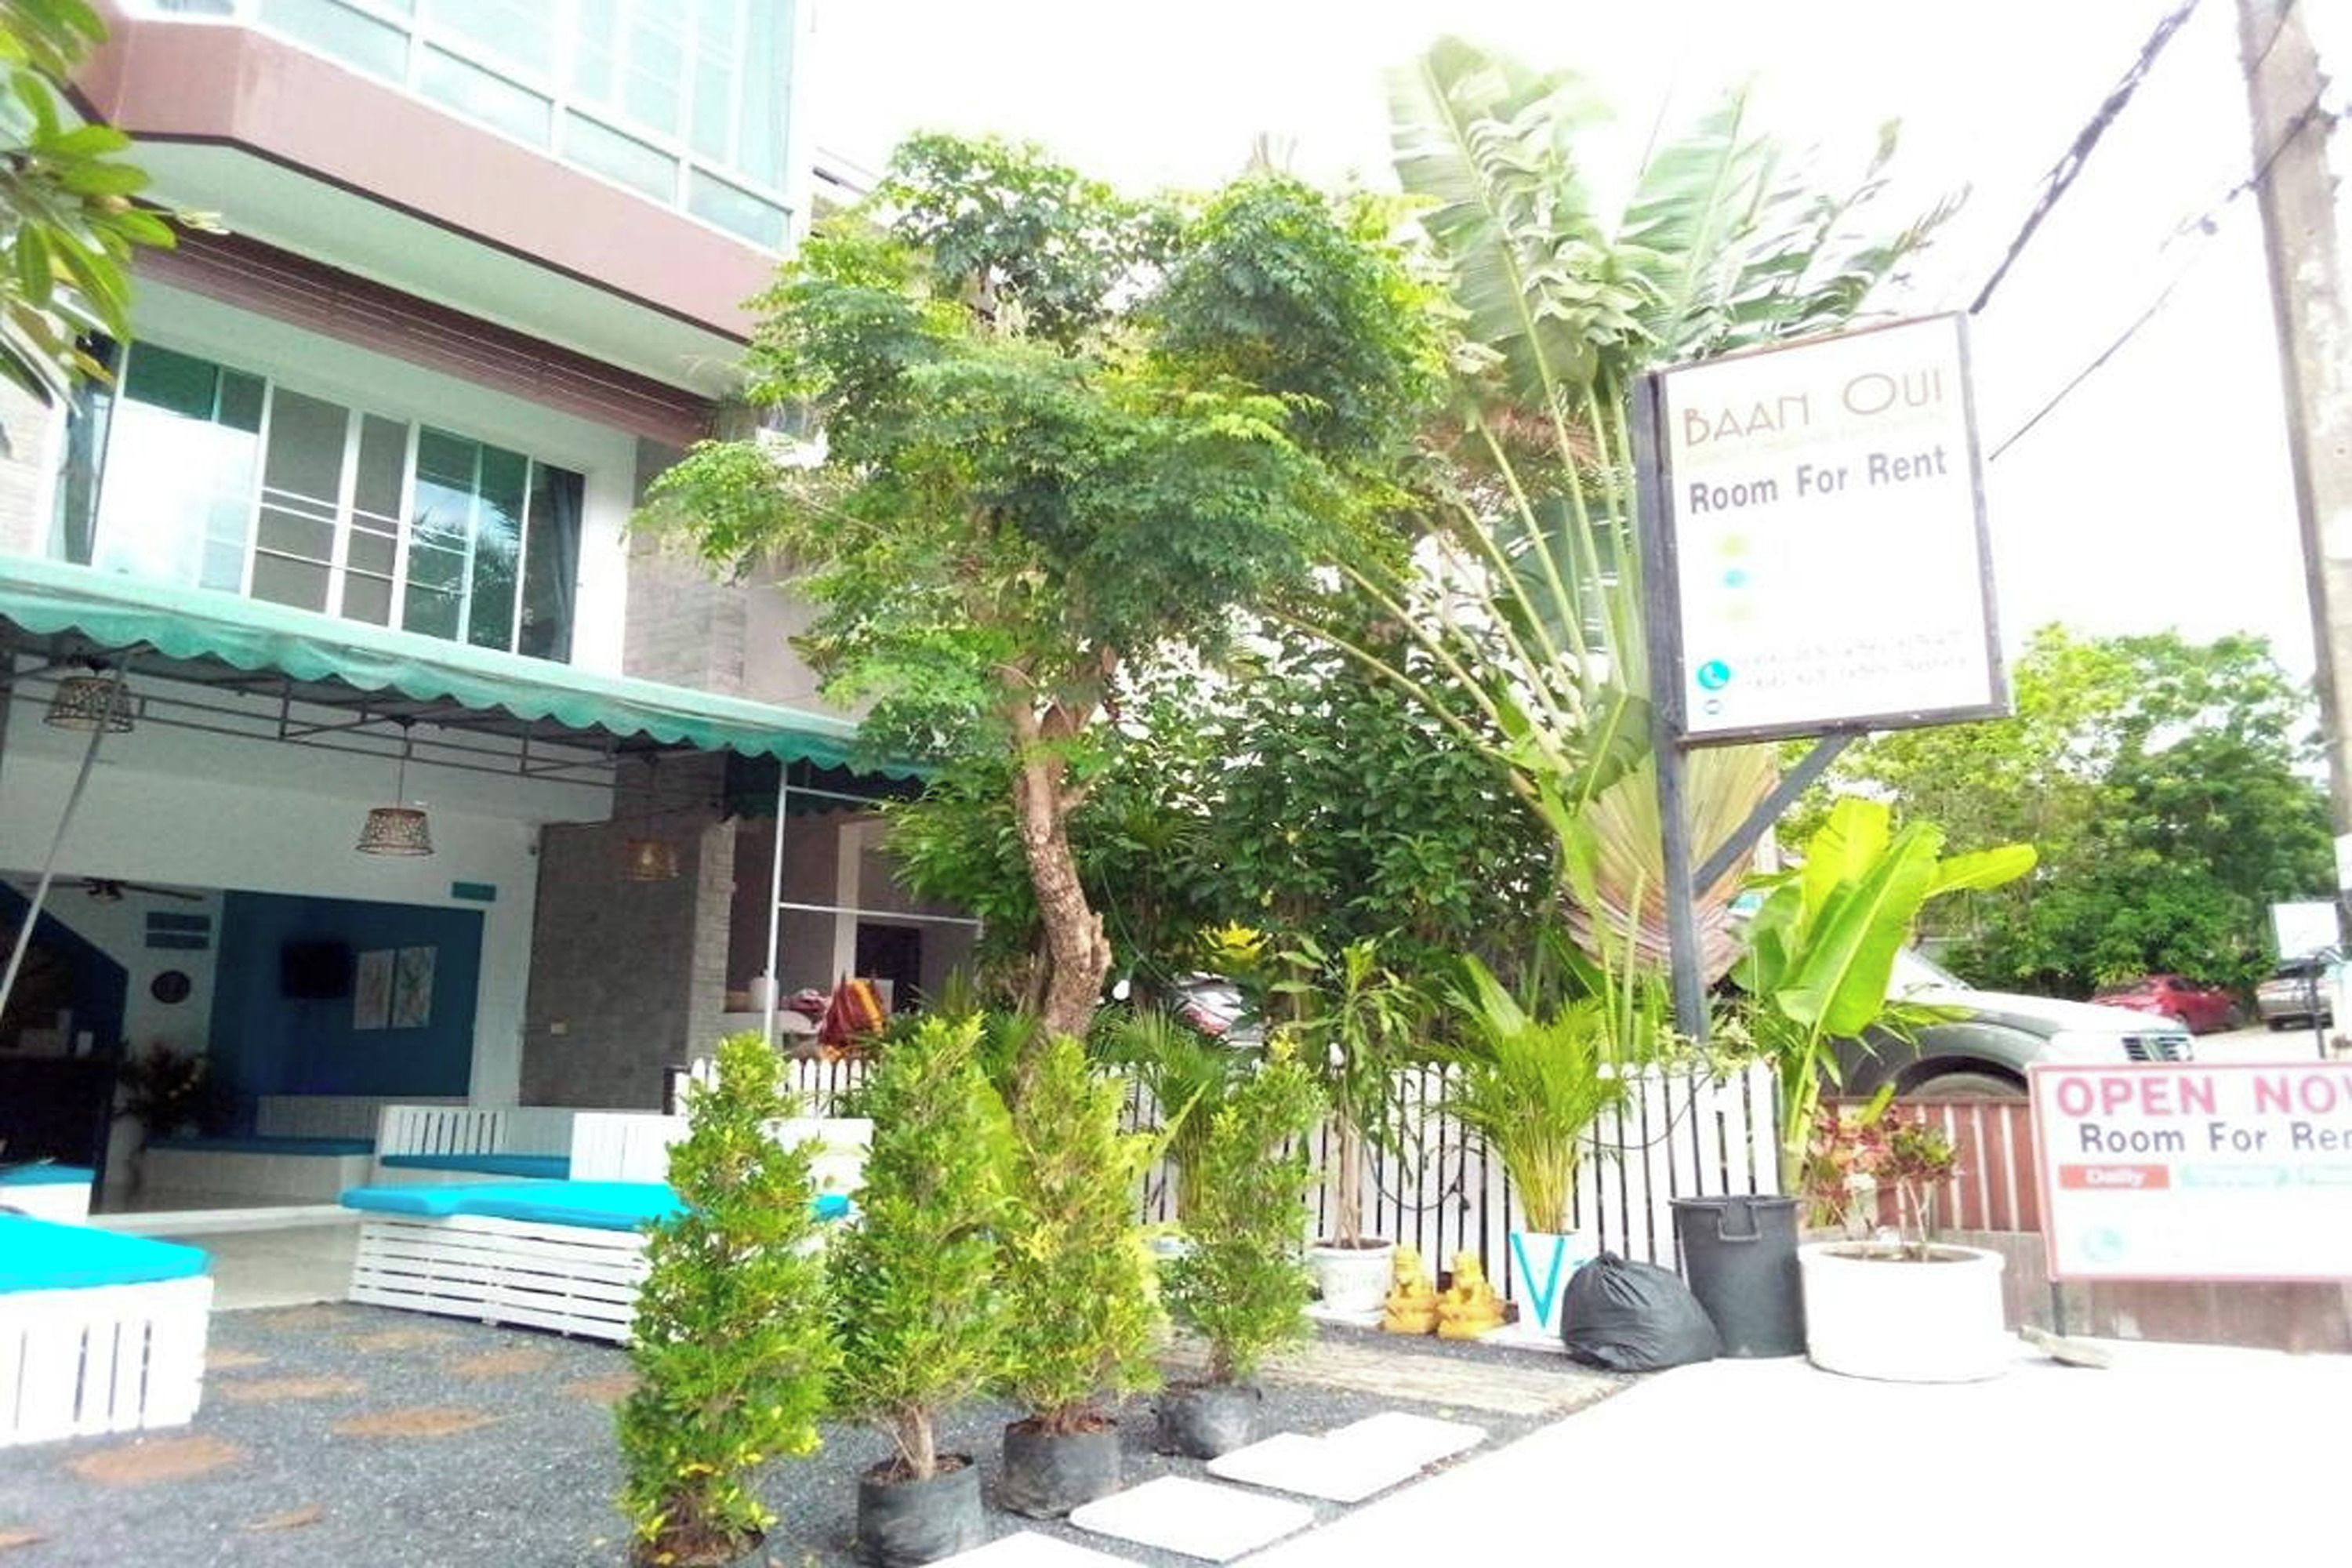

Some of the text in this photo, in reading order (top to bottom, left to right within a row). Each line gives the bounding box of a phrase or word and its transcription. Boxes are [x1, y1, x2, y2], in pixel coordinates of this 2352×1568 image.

[1682, 392, 1810, 447] BAAN
[1689, 445, 1948, 515] Room For Rent
[2056, 1076, 2217, 1117] OPEN
[2079, 1123, 2186, 1152] Room
[2208, 1121, 2268, 1152] For
